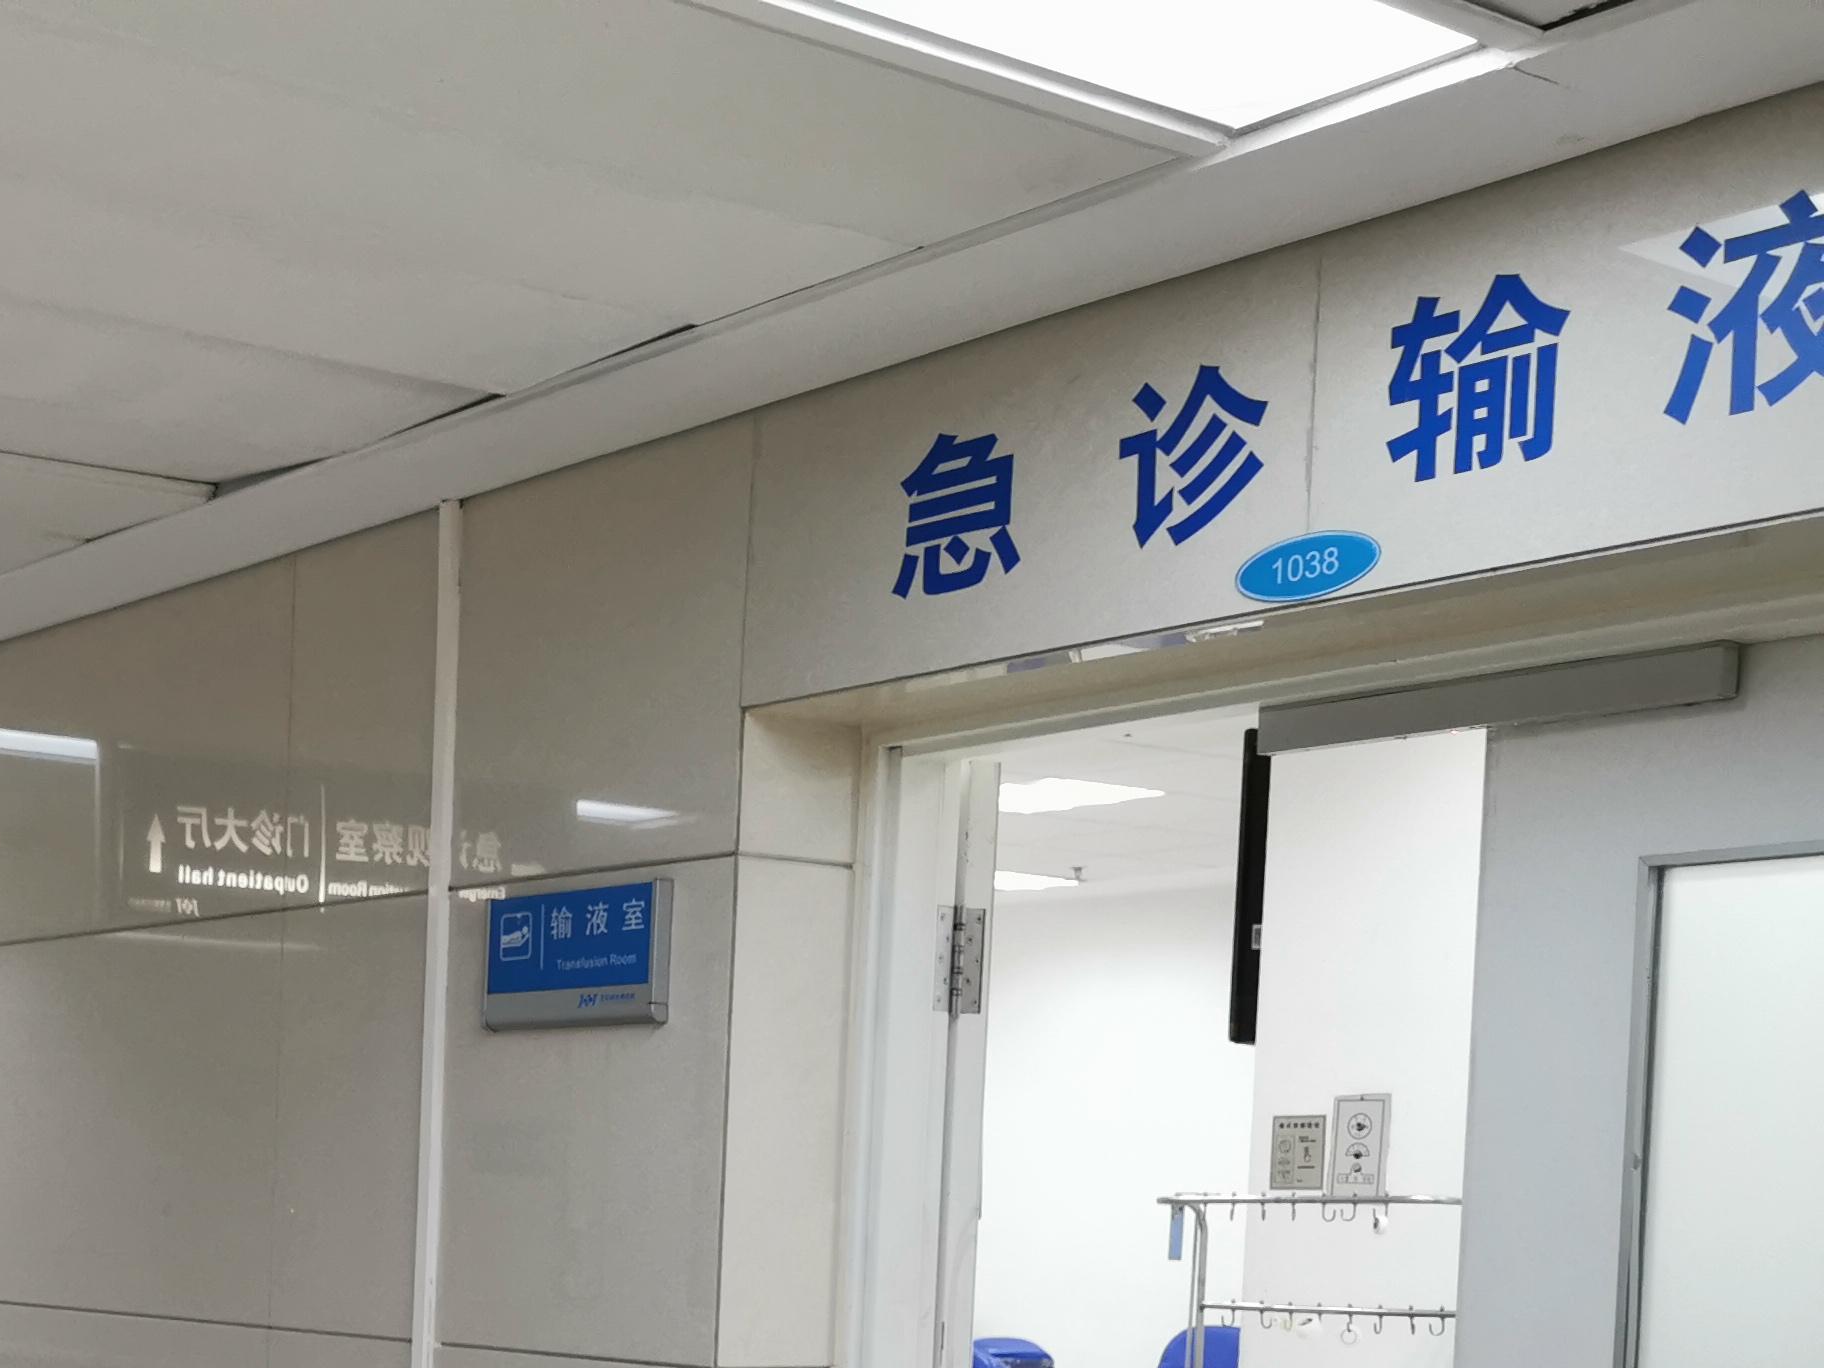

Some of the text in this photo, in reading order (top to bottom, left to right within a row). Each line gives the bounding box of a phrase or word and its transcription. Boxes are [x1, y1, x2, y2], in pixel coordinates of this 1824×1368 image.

[892, 189, 1824, 600] 急诊输液
[1271, 547, 1339, 585] 1038
[550, 898, 645, 940] 输液室
[556, 953, 638, 971] Transfusion Room
